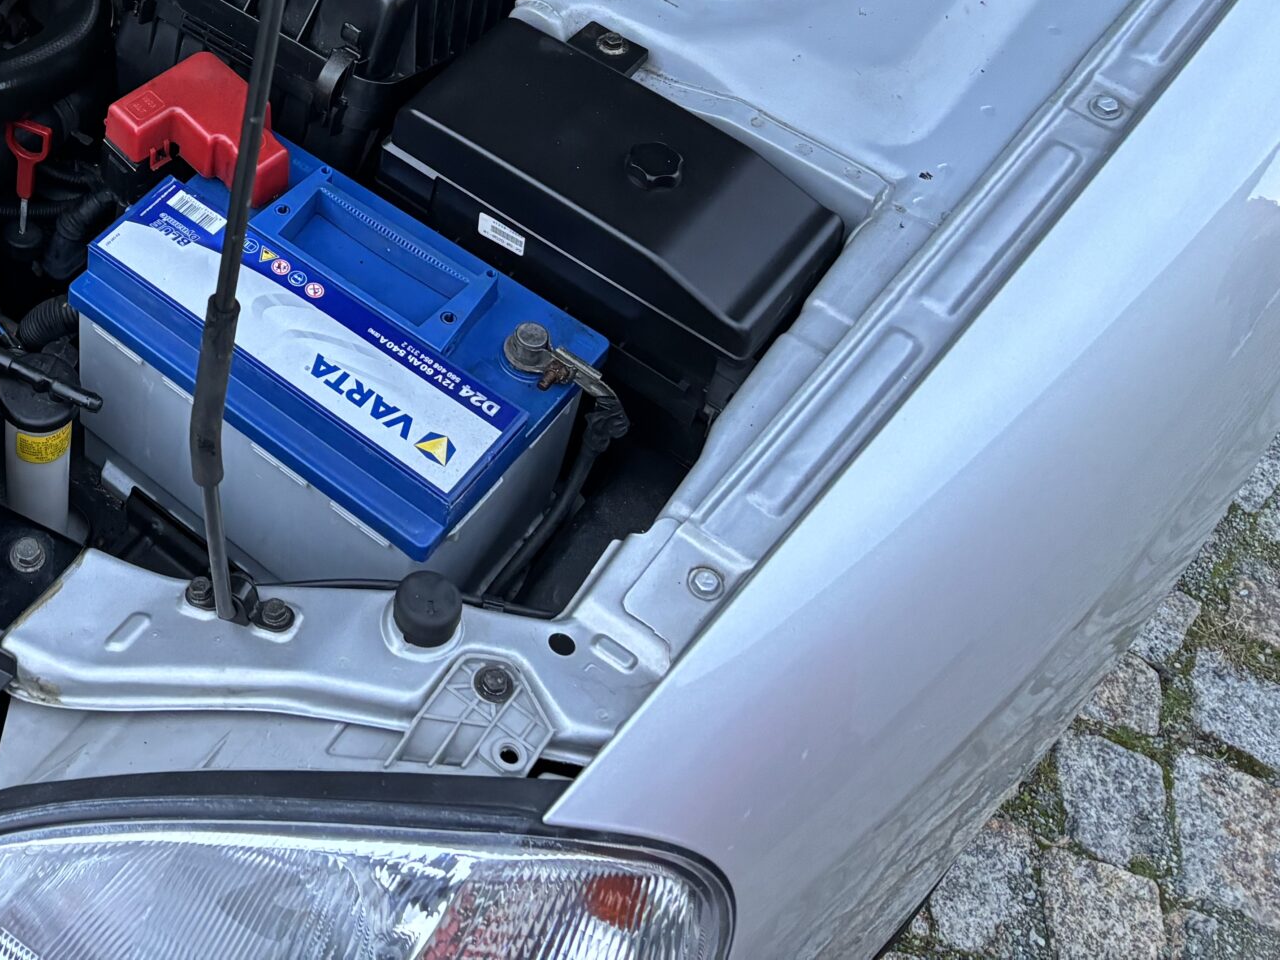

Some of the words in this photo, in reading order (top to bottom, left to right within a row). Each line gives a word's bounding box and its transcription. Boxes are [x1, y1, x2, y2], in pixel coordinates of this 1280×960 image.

[149, 219, 191, 247] BLUE
[159, 212, 200, 241] Dynamic
[406, 345, 420, 356] 313
[419, 353, 434, 365] 054
[407, 355, 434, 376] 60Ah
[432, 362, 447, 374] 408
[433, 373, 456, 390] 12V
[446, 372, 461, 383] 560
[311, 353, 413, 440] VARTA
[458, 385, 501, 417] D24
